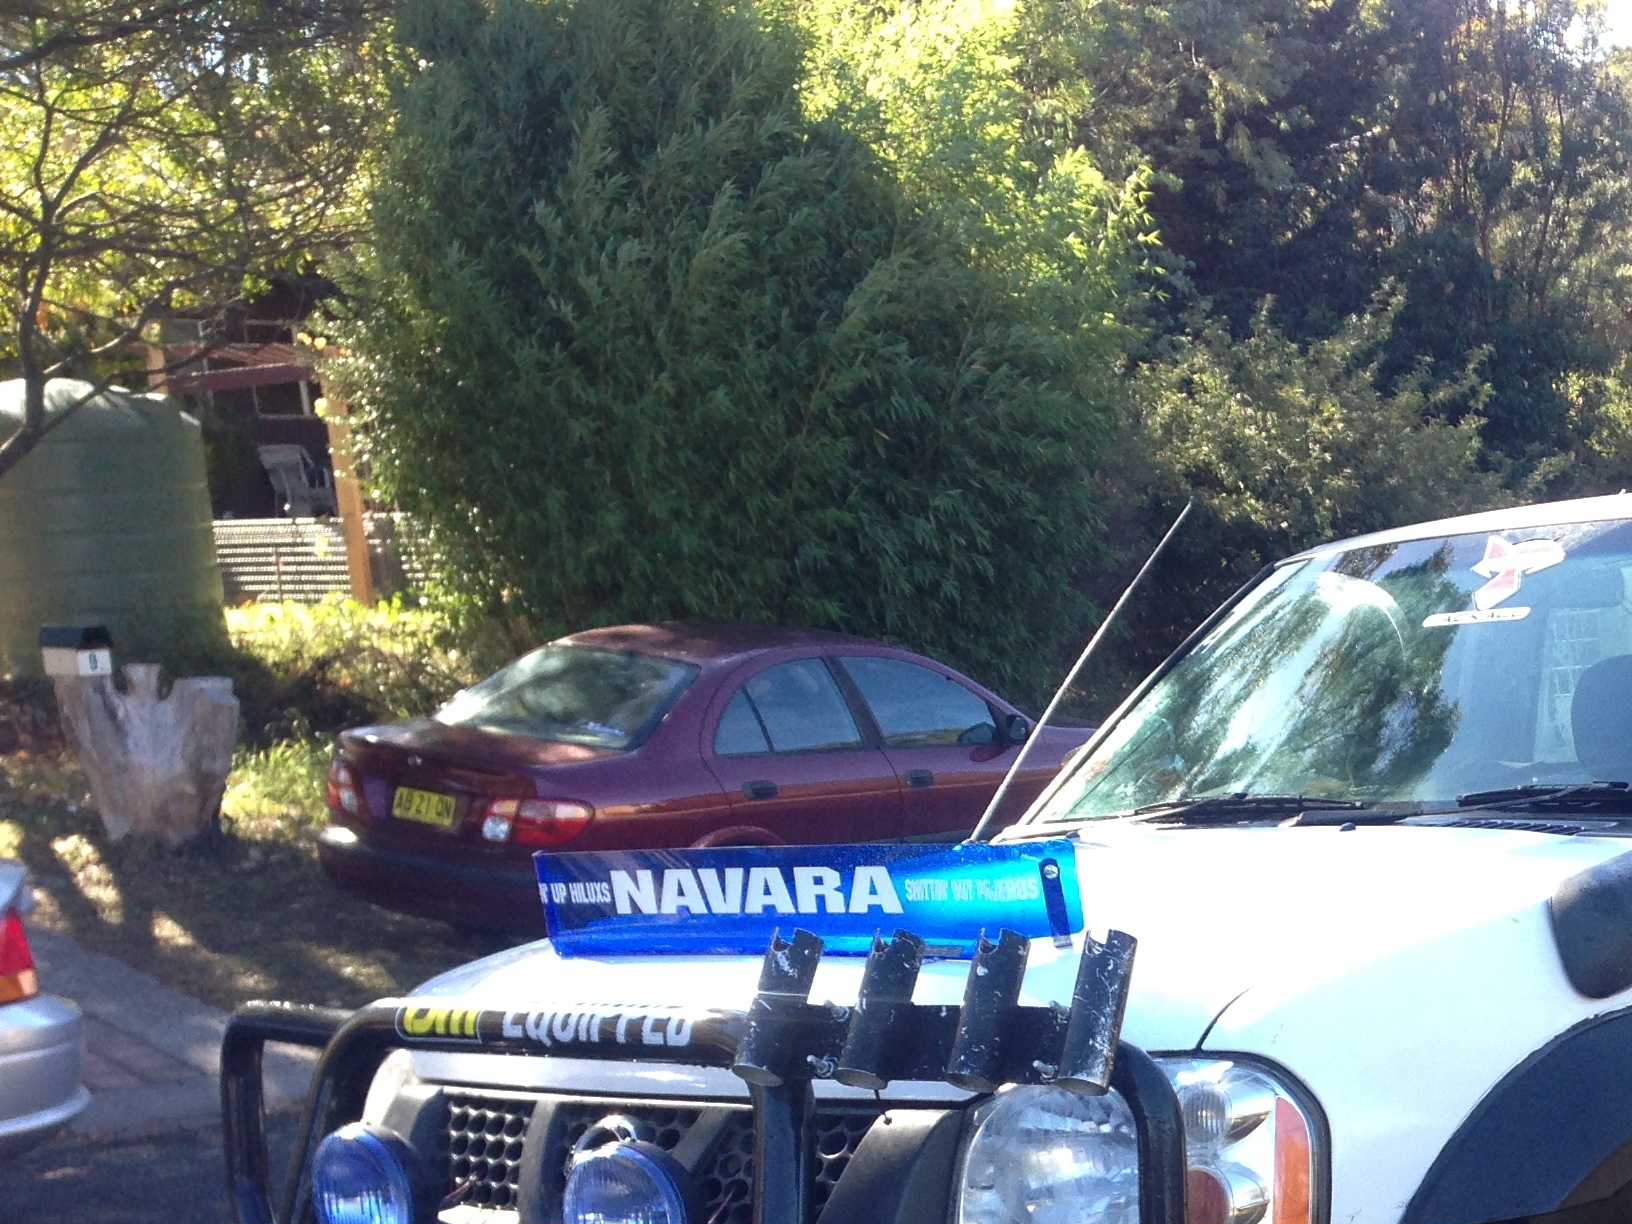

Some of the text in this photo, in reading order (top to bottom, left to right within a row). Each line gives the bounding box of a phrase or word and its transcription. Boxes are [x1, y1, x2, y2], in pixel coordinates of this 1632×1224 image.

[550, 882, 567, 904] UP
[568, 881, 612, 904] HILUXS
[609, 866, 904, 915] NAVARA
